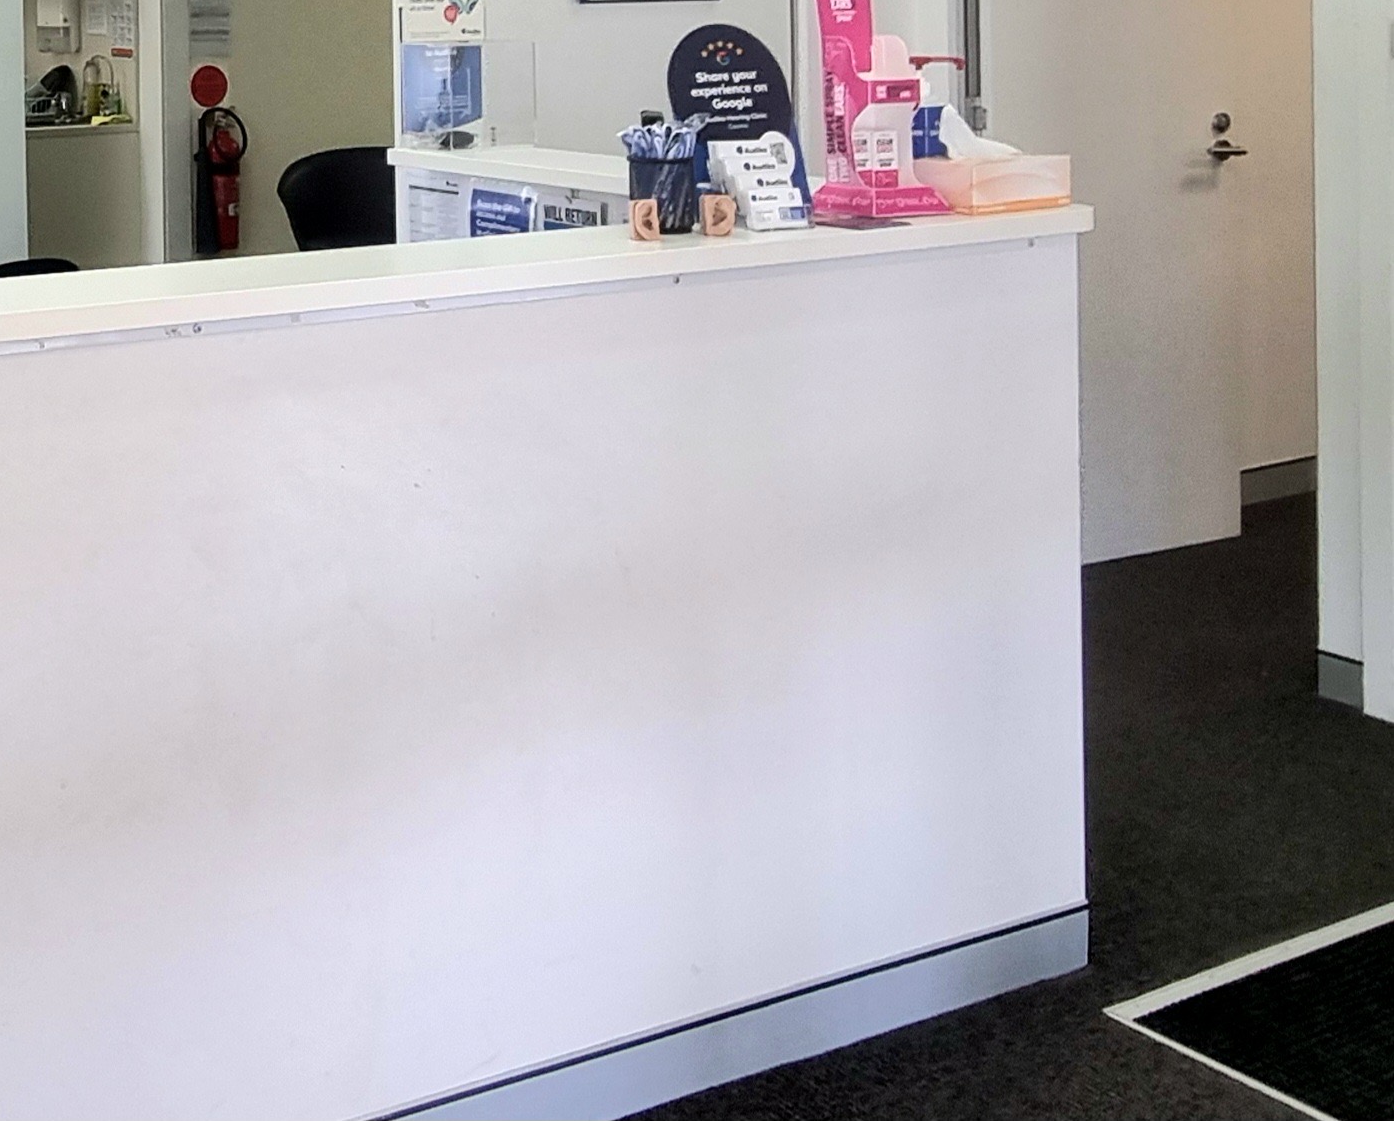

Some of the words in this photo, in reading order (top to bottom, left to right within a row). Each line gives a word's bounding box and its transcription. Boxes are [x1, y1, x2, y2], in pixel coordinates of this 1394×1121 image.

[695, 71, 729, 83] Share
[732, 71, 757, 83] your
[690, 83, 752, 98] experience
[753, 84, 768, 93] on
[712, 96, 753, 110] Google
[825, 113, 836, 155] SIMPLE
[835, 116, 847, 154] CLEAN
[543, 204, 564, 222] WILL
[565, 207, 598, 226] RETURN
